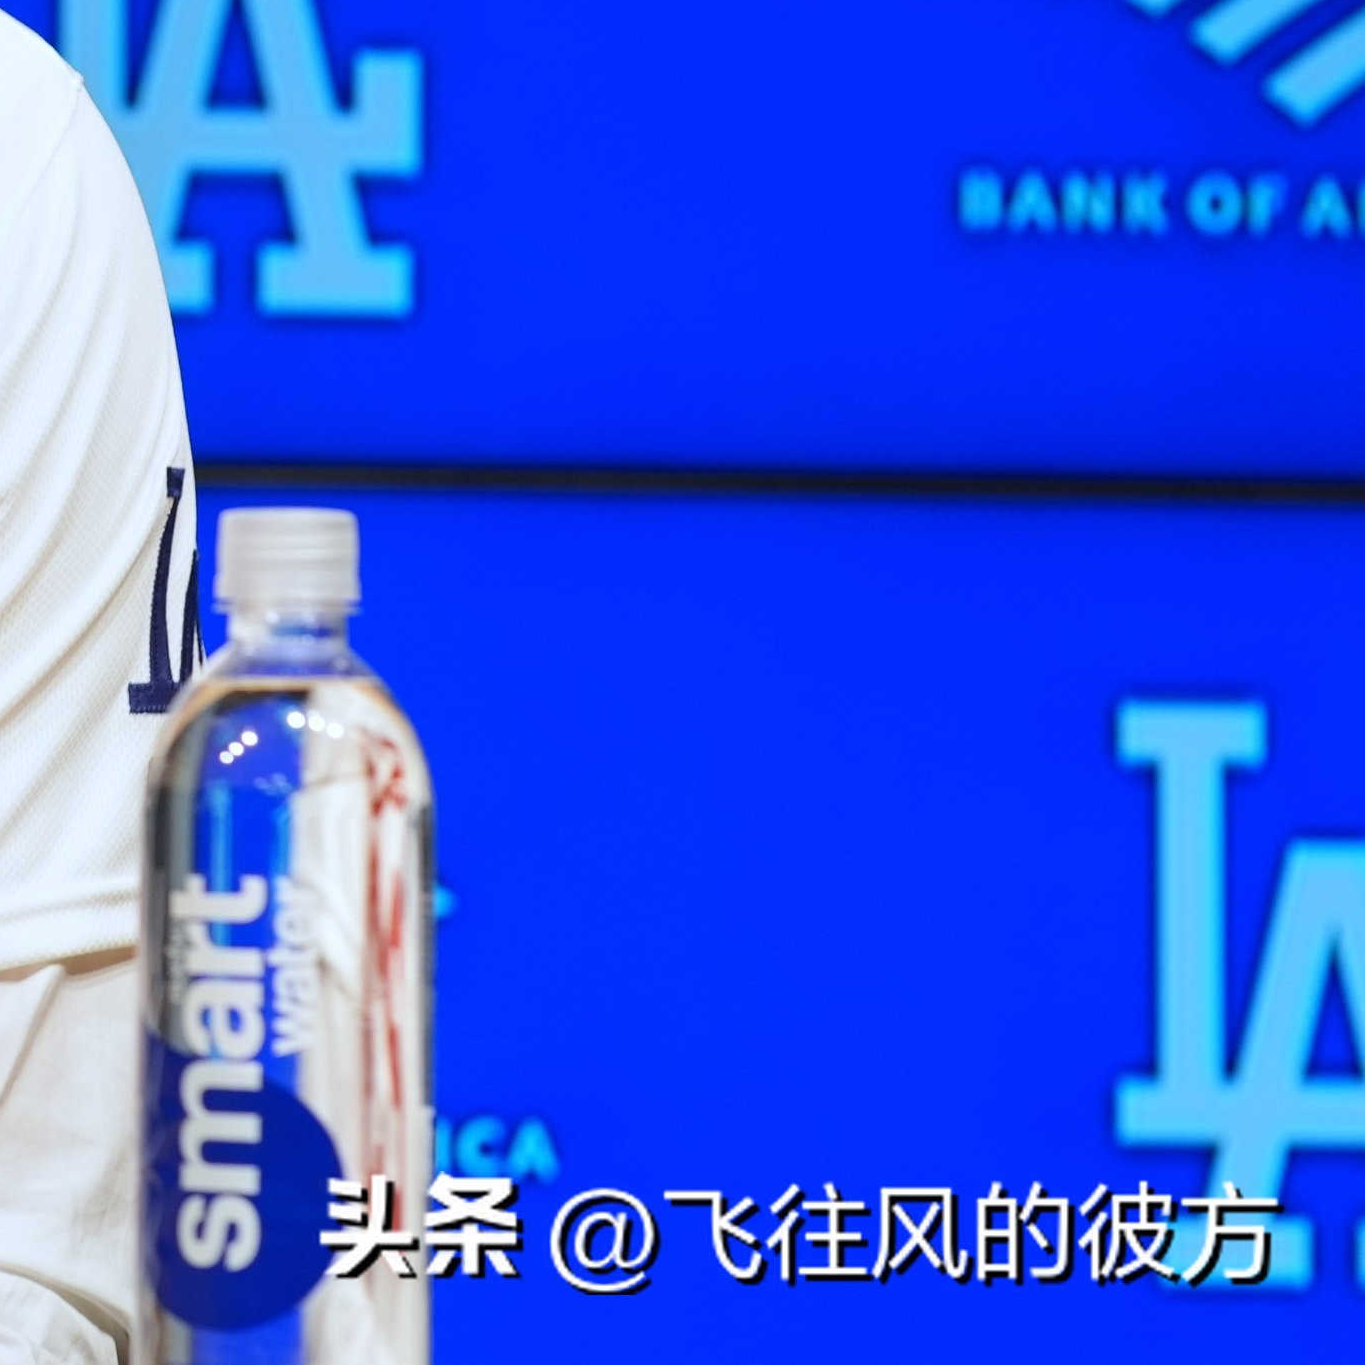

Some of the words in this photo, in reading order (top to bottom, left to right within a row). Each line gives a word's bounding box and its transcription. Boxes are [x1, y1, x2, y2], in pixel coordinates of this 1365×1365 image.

[959, 168, 1167, 236] BANK
[1186, 171, 1285, 237] OF
[267, 873, 321, 1059] water
[170, 872, 269, 1273] smart
